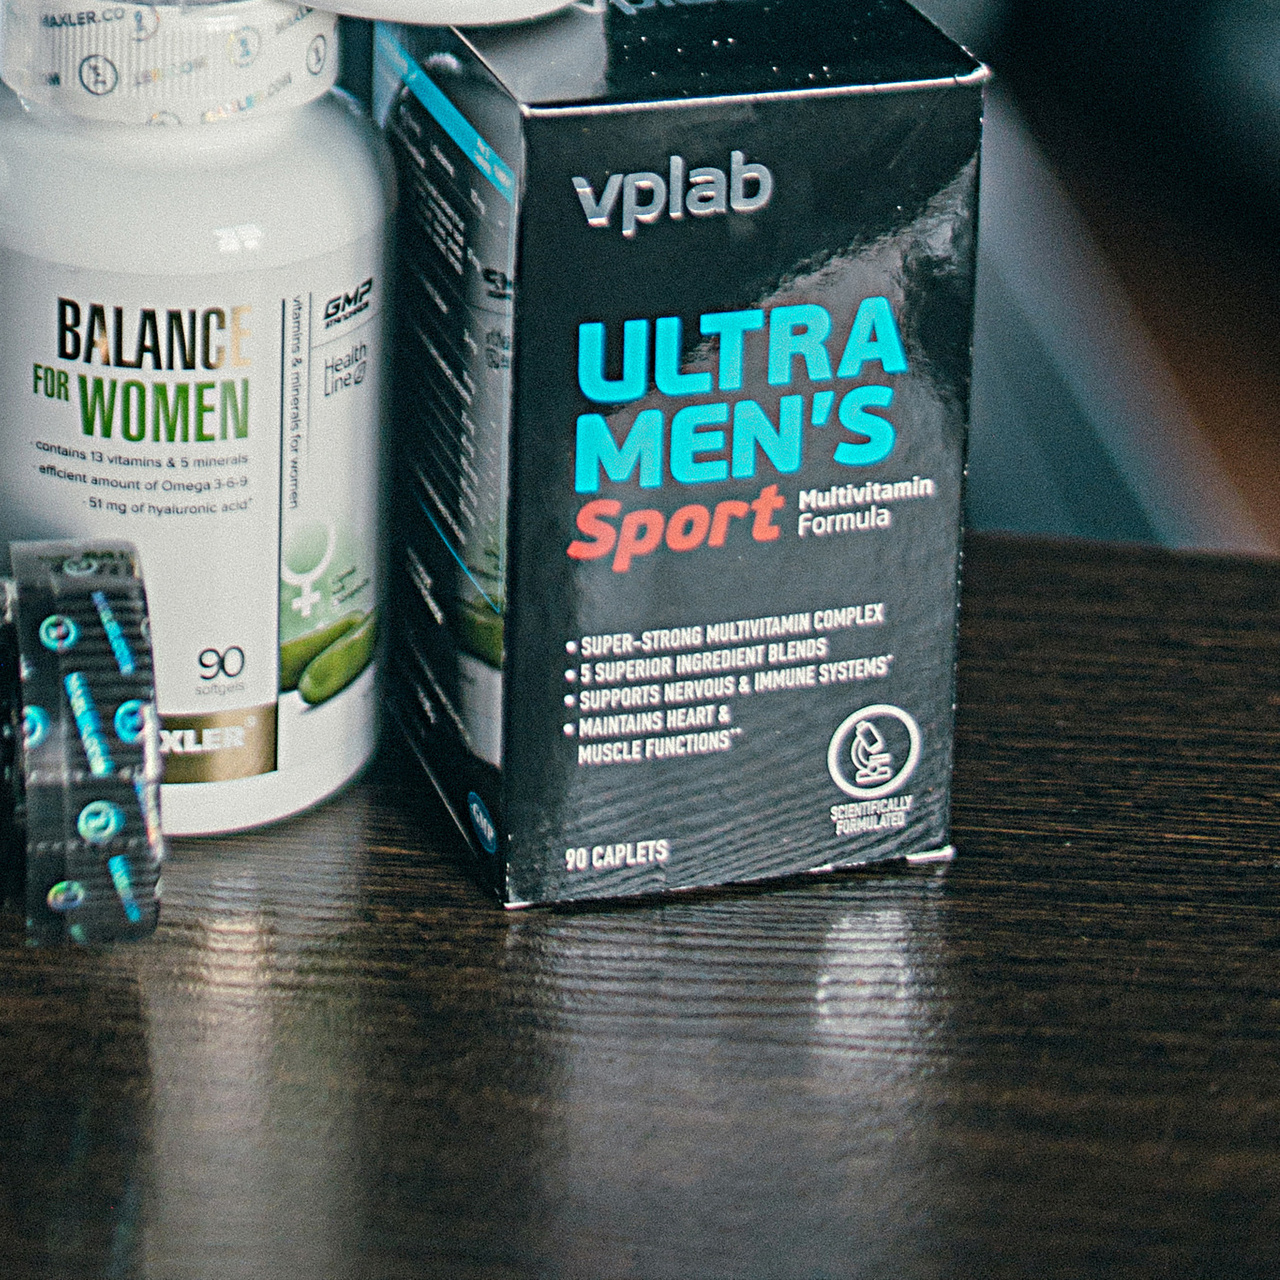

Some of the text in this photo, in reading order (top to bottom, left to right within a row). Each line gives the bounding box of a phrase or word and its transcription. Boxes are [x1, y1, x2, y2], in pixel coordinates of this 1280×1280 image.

[571, 150, 773, 238] vplab
[324, 277, 373, 320] GMP
[57, 297, 252, 370] BALANCE
[578, 296, 908, 403] ULTRA
[324, 342, 367, 374] Health
[324, 370, 352, 397] Line
[33, 363, 249, 442] FOR WOMEN
[290, 295, 302, 509] vitamins & minerals for women
[35, 441, 248, 468] contains 13 vitamins & 5 minerals
[574, 384, 896, 494] MEN'S
[39, 464, 248, 493] efficient amount of Omega 3-6-9
[798, 476, 934, 511] Multivitamin
[89, 497, 102, 509] 51
[106, 500, 126, 514] mg
[131, 500, 144, 513] of
[148, 500, 217, 517] hyaluronic
[798, 506, 892, 538] Formula
[566, 483, 785, 573] Sport
[580, 603, 885, 658] SUPER-STRONG MULTIVITAMIN COMPLEX
[198, 645, 245, 680] 90
[579, 637, 829, 685] 5 SUPERIOR INGREDIENT BLENDS
[195, 681, 245, 696] softgels
[579, 685, 661, 711] SUPPORTS
[663, 676, 735, 703] NERVOUS
[738, 675, 751, 695] &
[754, 666, 817, 691] IMMUNE
[578, 704, 732, 738] MAINTAINS HEART &
[159, 726, 245, 753] XLER
[578, 740, 642, 765] MUSCLE
[830, 795, 914, 822] SCIENTIFICALLY
[835, 811, 906, 836] FORMULATED
[565, 839, 670, 871] 90 CAPLETS
